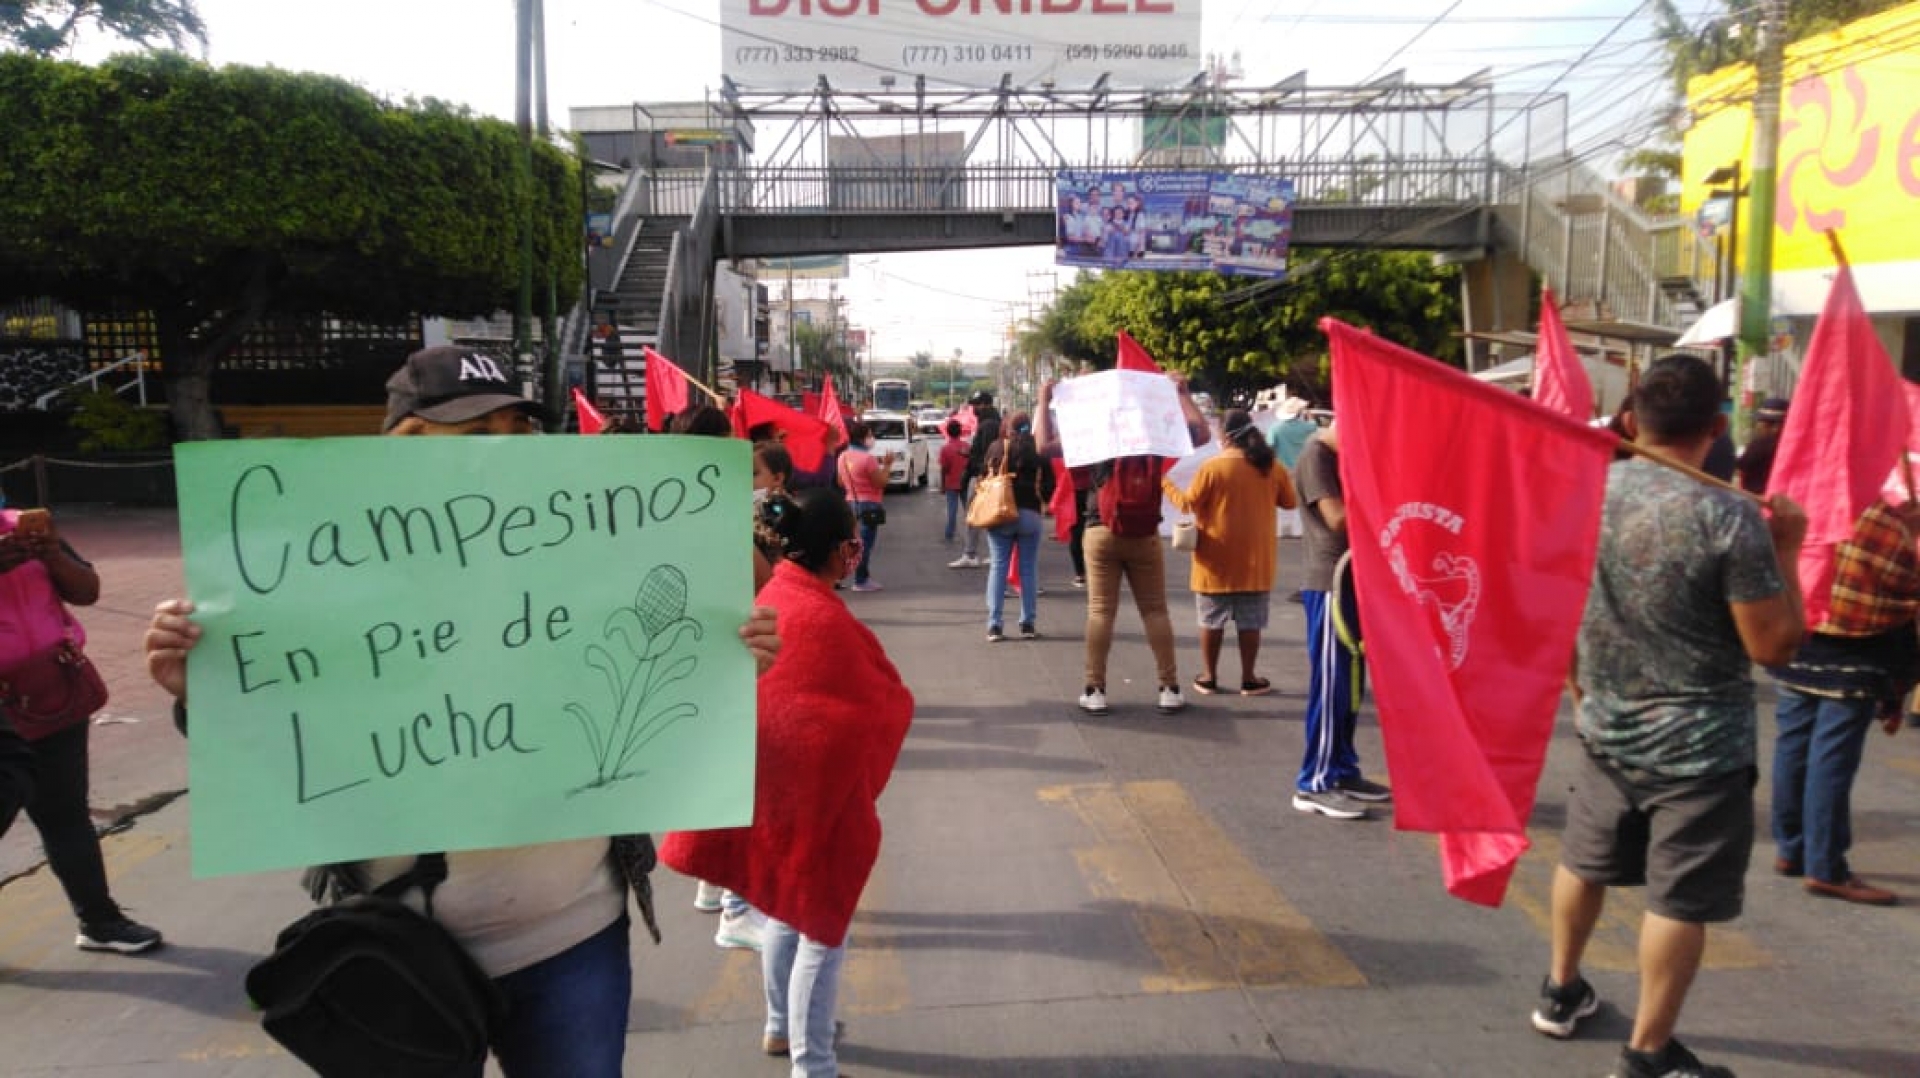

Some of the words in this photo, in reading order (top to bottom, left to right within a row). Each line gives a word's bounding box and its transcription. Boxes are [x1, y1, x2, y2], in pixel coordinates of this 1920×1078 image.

[735, 45, 779, 65] (777)
[902, 45, 948, 65] (777)
[954, 45, 985, 61] 310
[991, 44, 1031, 60] 0411
[231, 630, 320, 694] En
[502, 591, 572, 649] de
[291, 693, 543, 804] Lucha
